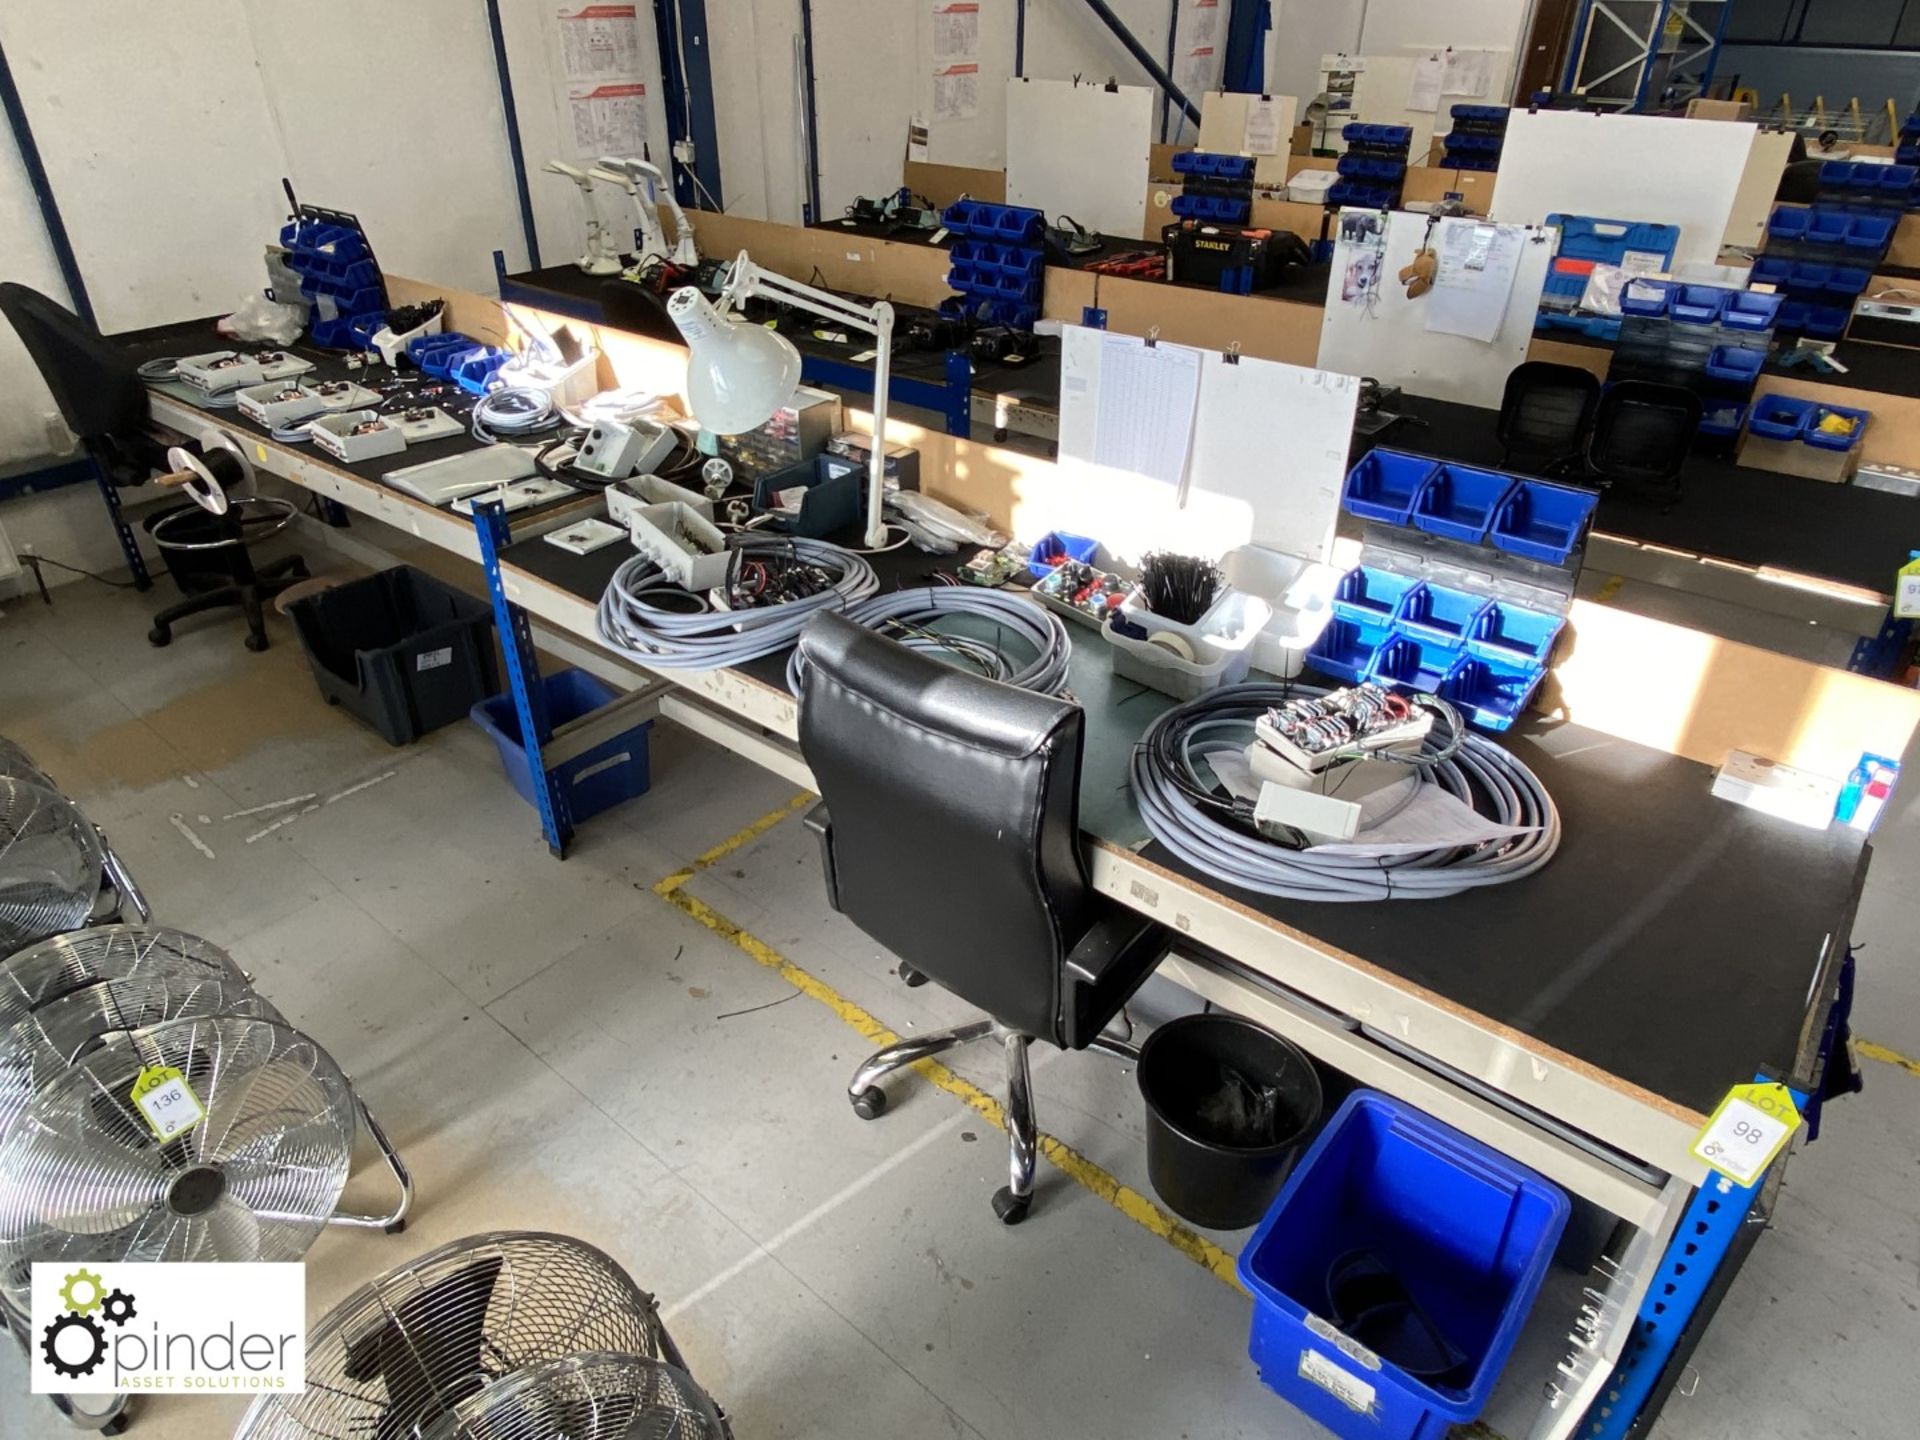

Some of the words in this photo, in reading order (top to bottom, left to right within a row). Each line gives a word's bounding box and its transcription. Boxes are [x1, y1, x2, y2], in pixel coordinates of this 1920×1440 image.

[1195, 239, 1231, 252] STANLEY
[139, 1070, 170, 1094] LOT
[152, 1088, 182, 1111] 136
[1744, 1088, 1792, 1118] LOT
[1732, 1120, 1763, 1145] 98
